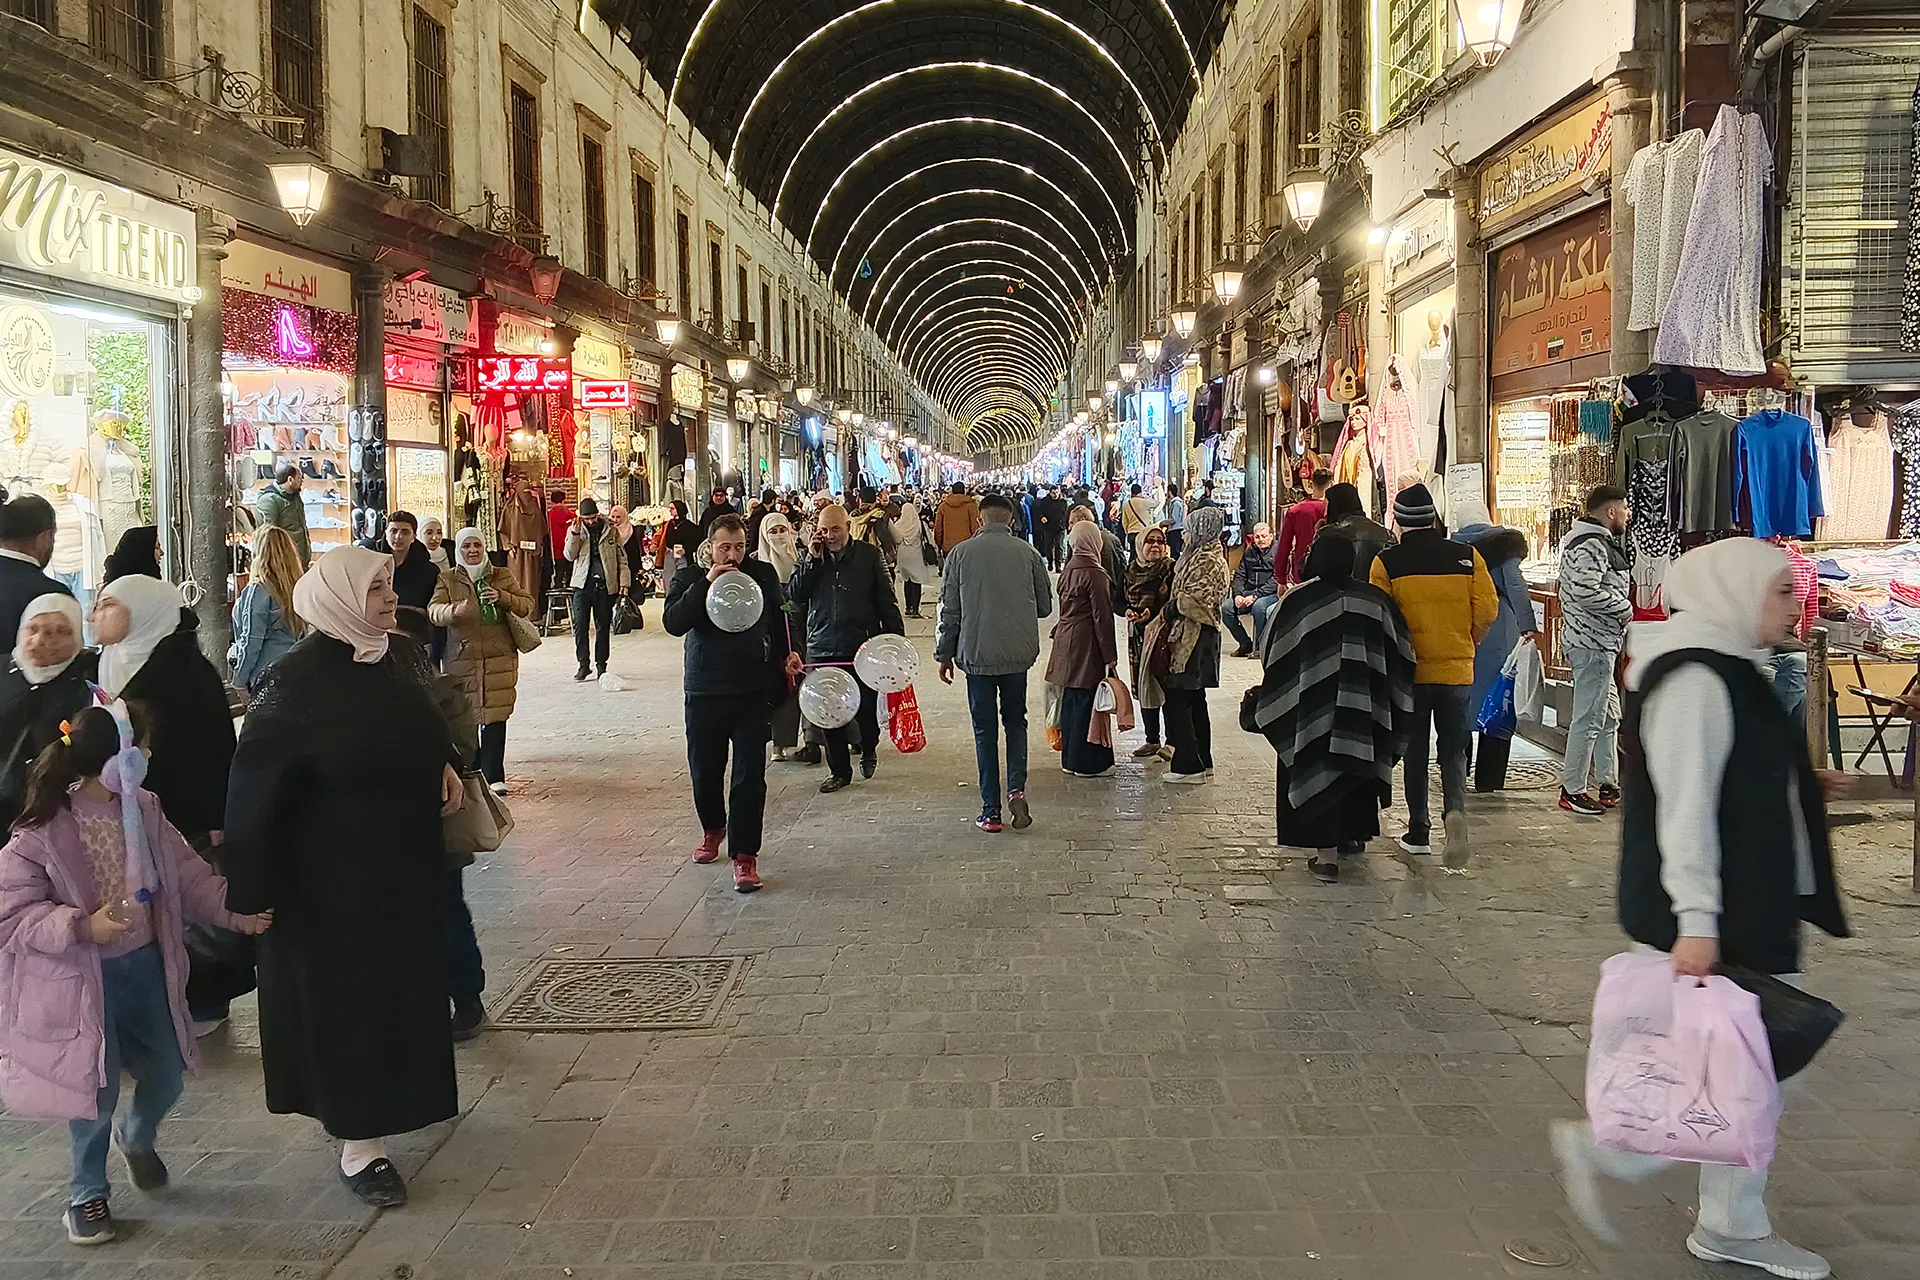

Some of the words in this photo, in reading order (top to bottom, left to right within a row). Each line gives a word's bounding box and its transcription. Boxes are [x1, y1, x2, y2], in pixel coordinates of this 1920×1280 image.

[1578, 101, 1611, 171] مجوهرات
[98, 213, 188, 288] TREND
[263, 266, 317, 301] الهيثم
[1498, 255, 1555, 337] الشام
[1531, 312, 1558, 335] الذهب
[1559, 304, 1588, 328] لتجارة
[514, 358, 539, 382] الله
